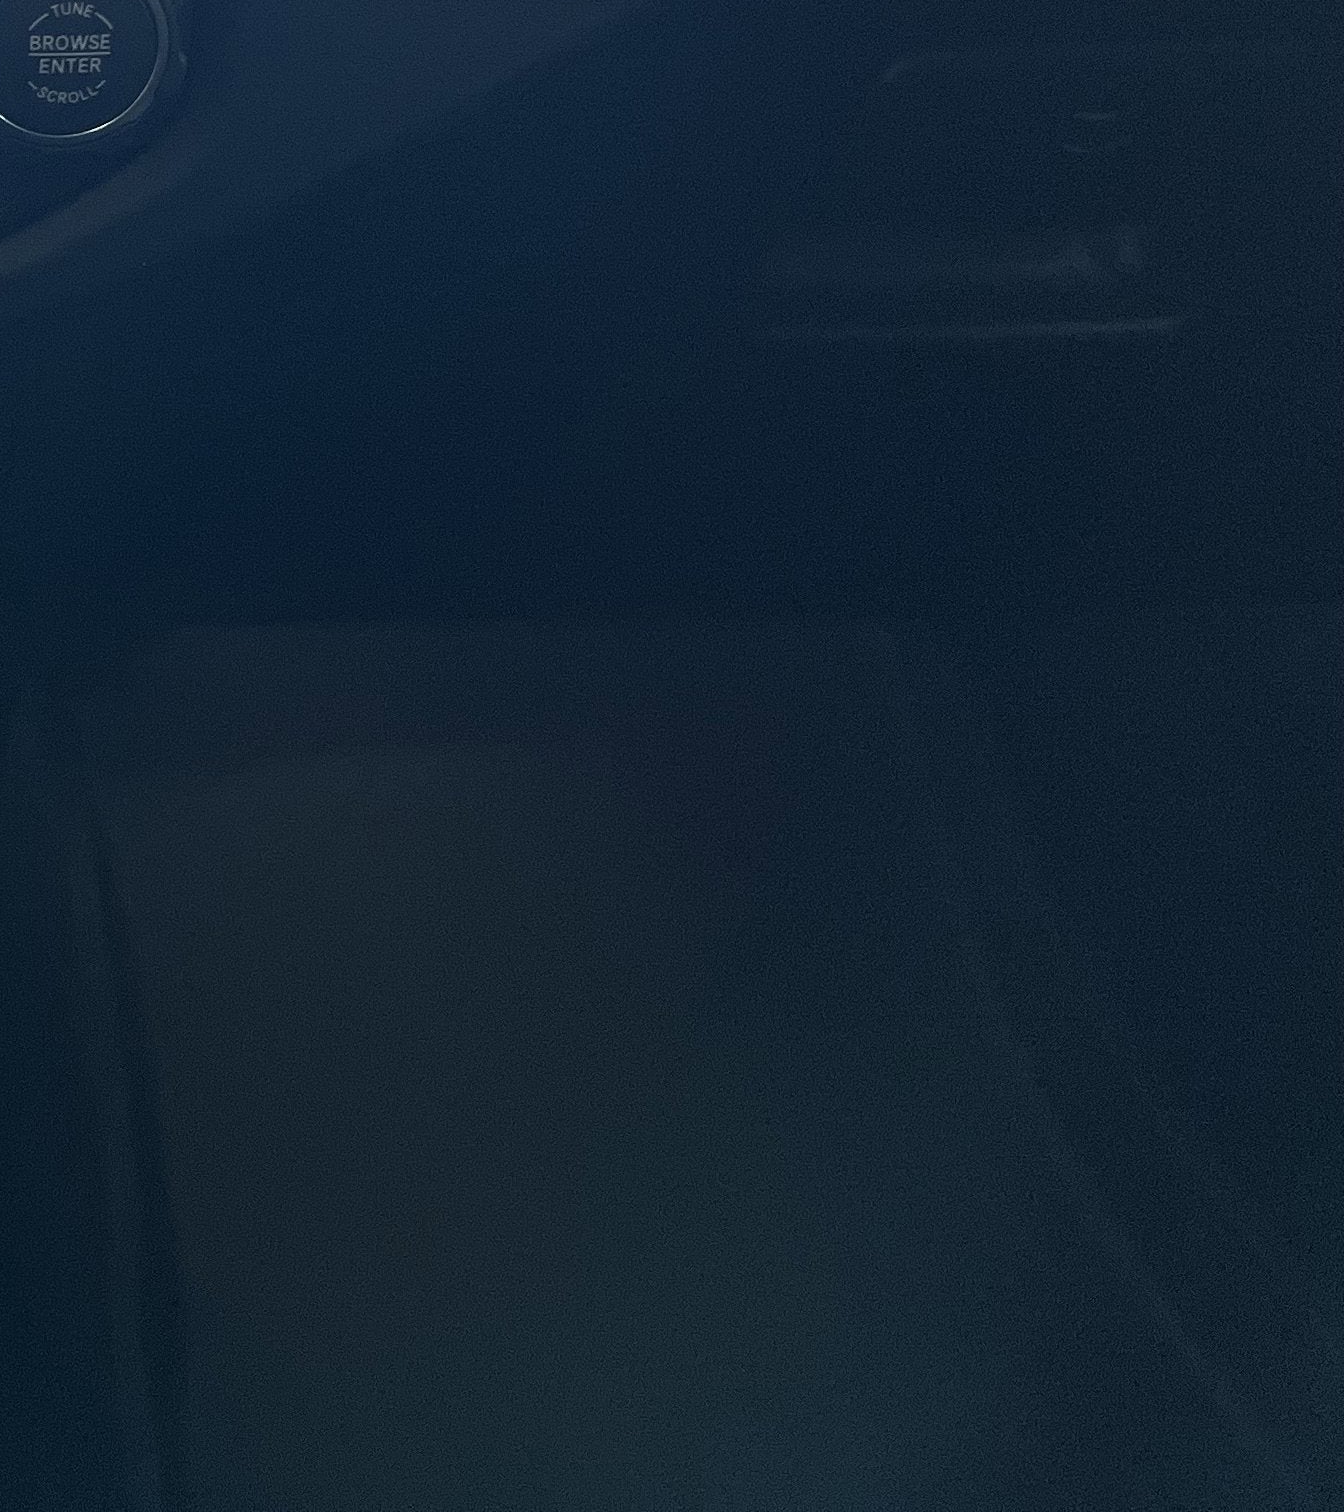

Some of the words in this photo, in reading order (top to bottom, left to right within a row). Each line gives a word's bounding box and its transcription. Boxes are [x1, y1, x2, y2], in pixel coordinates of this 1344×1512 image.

[50, 2, 94, 19] TUNE
[28, 34, 111, 52] BROWSE
[38, 57, 102, 75] ENTER
[35, 85, 100, 104] SCROLL
